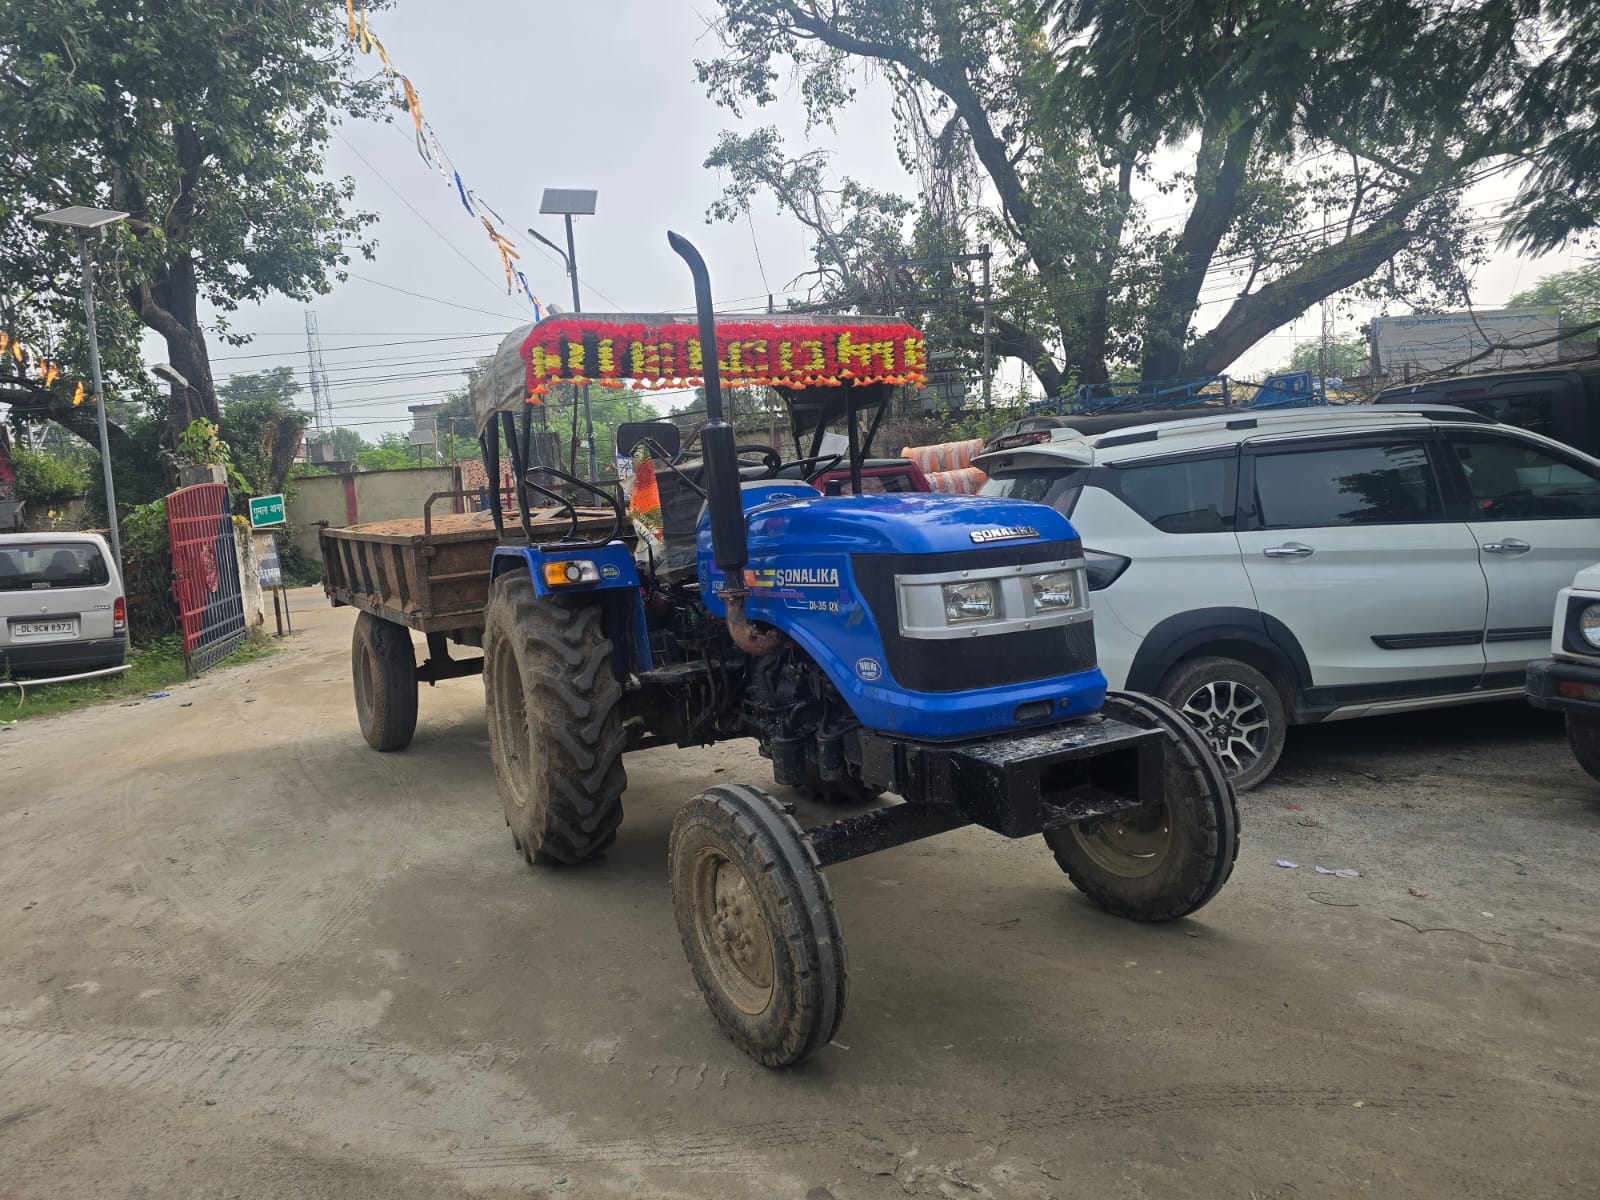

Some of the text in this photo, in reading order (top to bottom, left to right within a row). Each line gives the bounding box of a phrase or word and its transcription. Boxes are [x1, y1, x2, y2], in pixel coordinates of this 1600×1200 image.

[970, 525, 1040, 543] SONALIKA
[776, 568, 839, 587] SONALIKA
[808, 600, 827, 611] DI-35
[21, 624, 32, 633] DL
[51, 623, 71, 632] 8973
